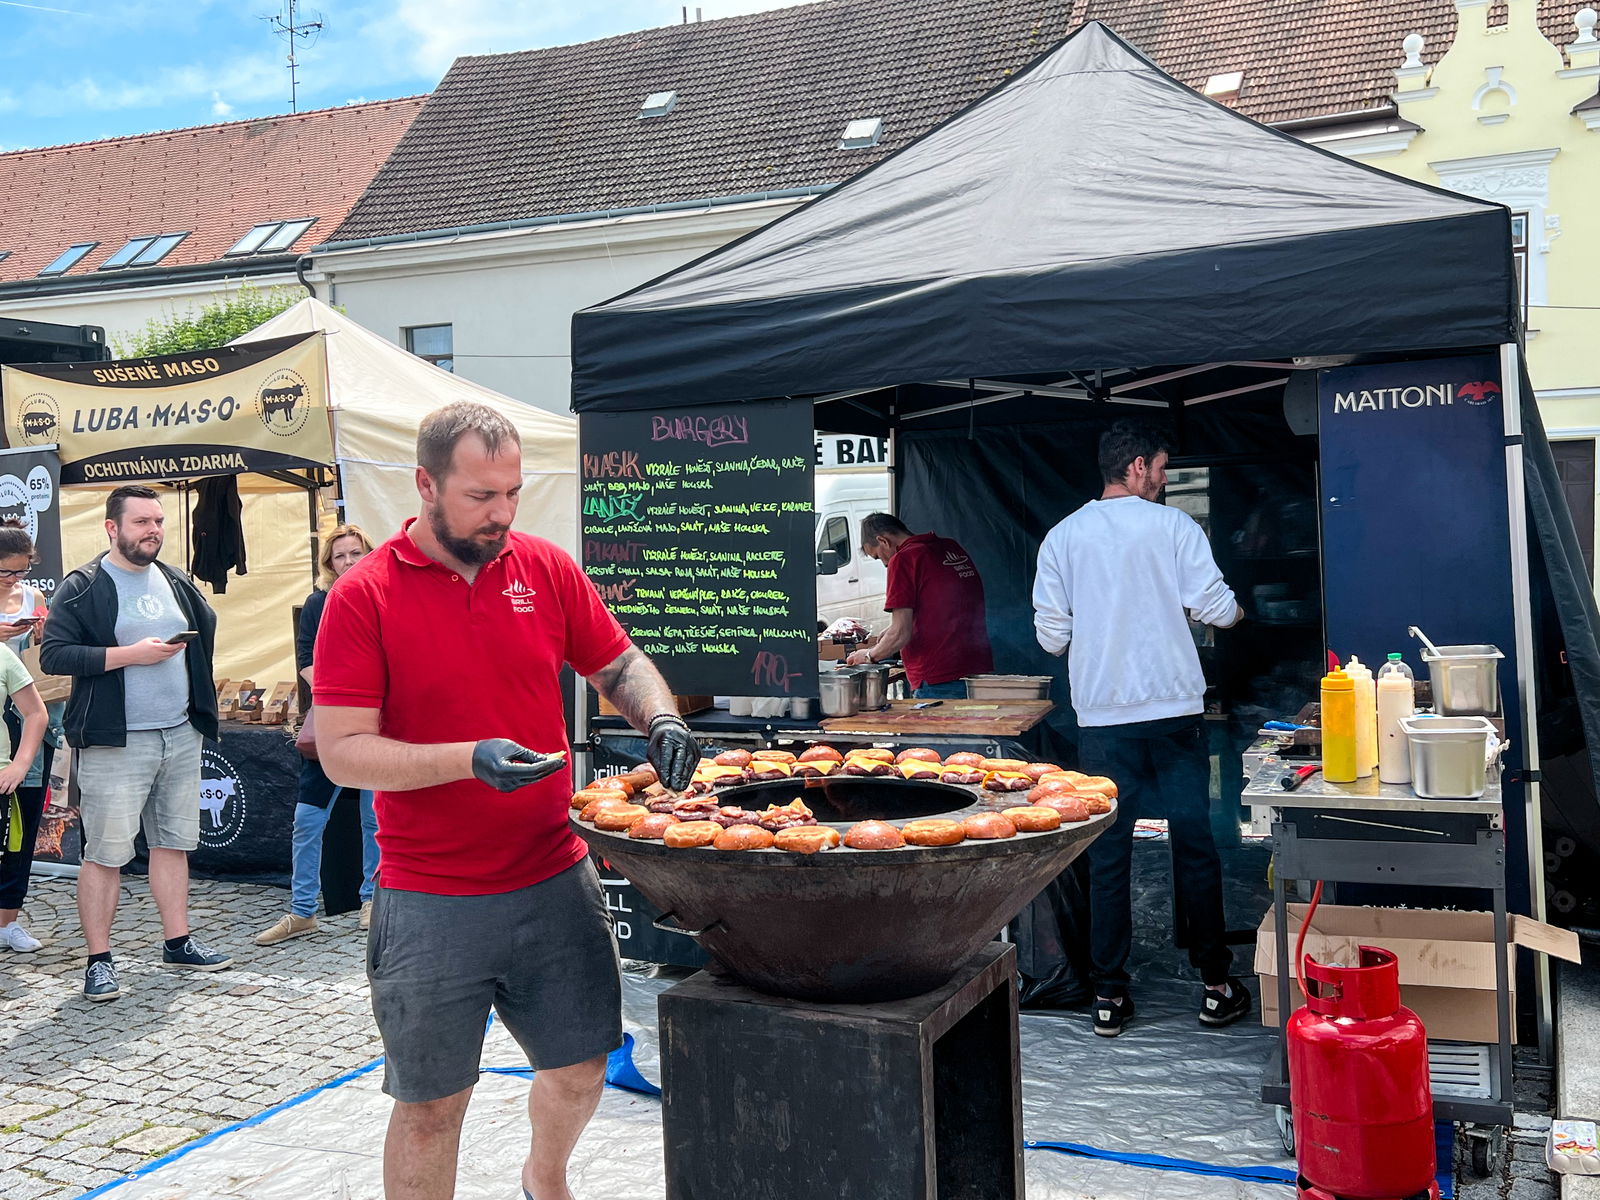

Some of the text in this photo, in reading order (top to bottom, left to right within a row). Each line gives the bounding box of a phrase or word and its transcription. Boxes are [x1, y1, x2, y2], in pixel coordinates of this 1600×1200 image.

[93, 357, 220, 383] SUŠENÉ MASO
[1333, 383, 1454, 414] MATTONI
[73, 405, 139, 433] LUBA
[84, 453, 245, 478] OCHUTNÁVKA ZDARMA
[583, 450, 646, 480] KLASIK
[30, 477, 50, 490] 65%
